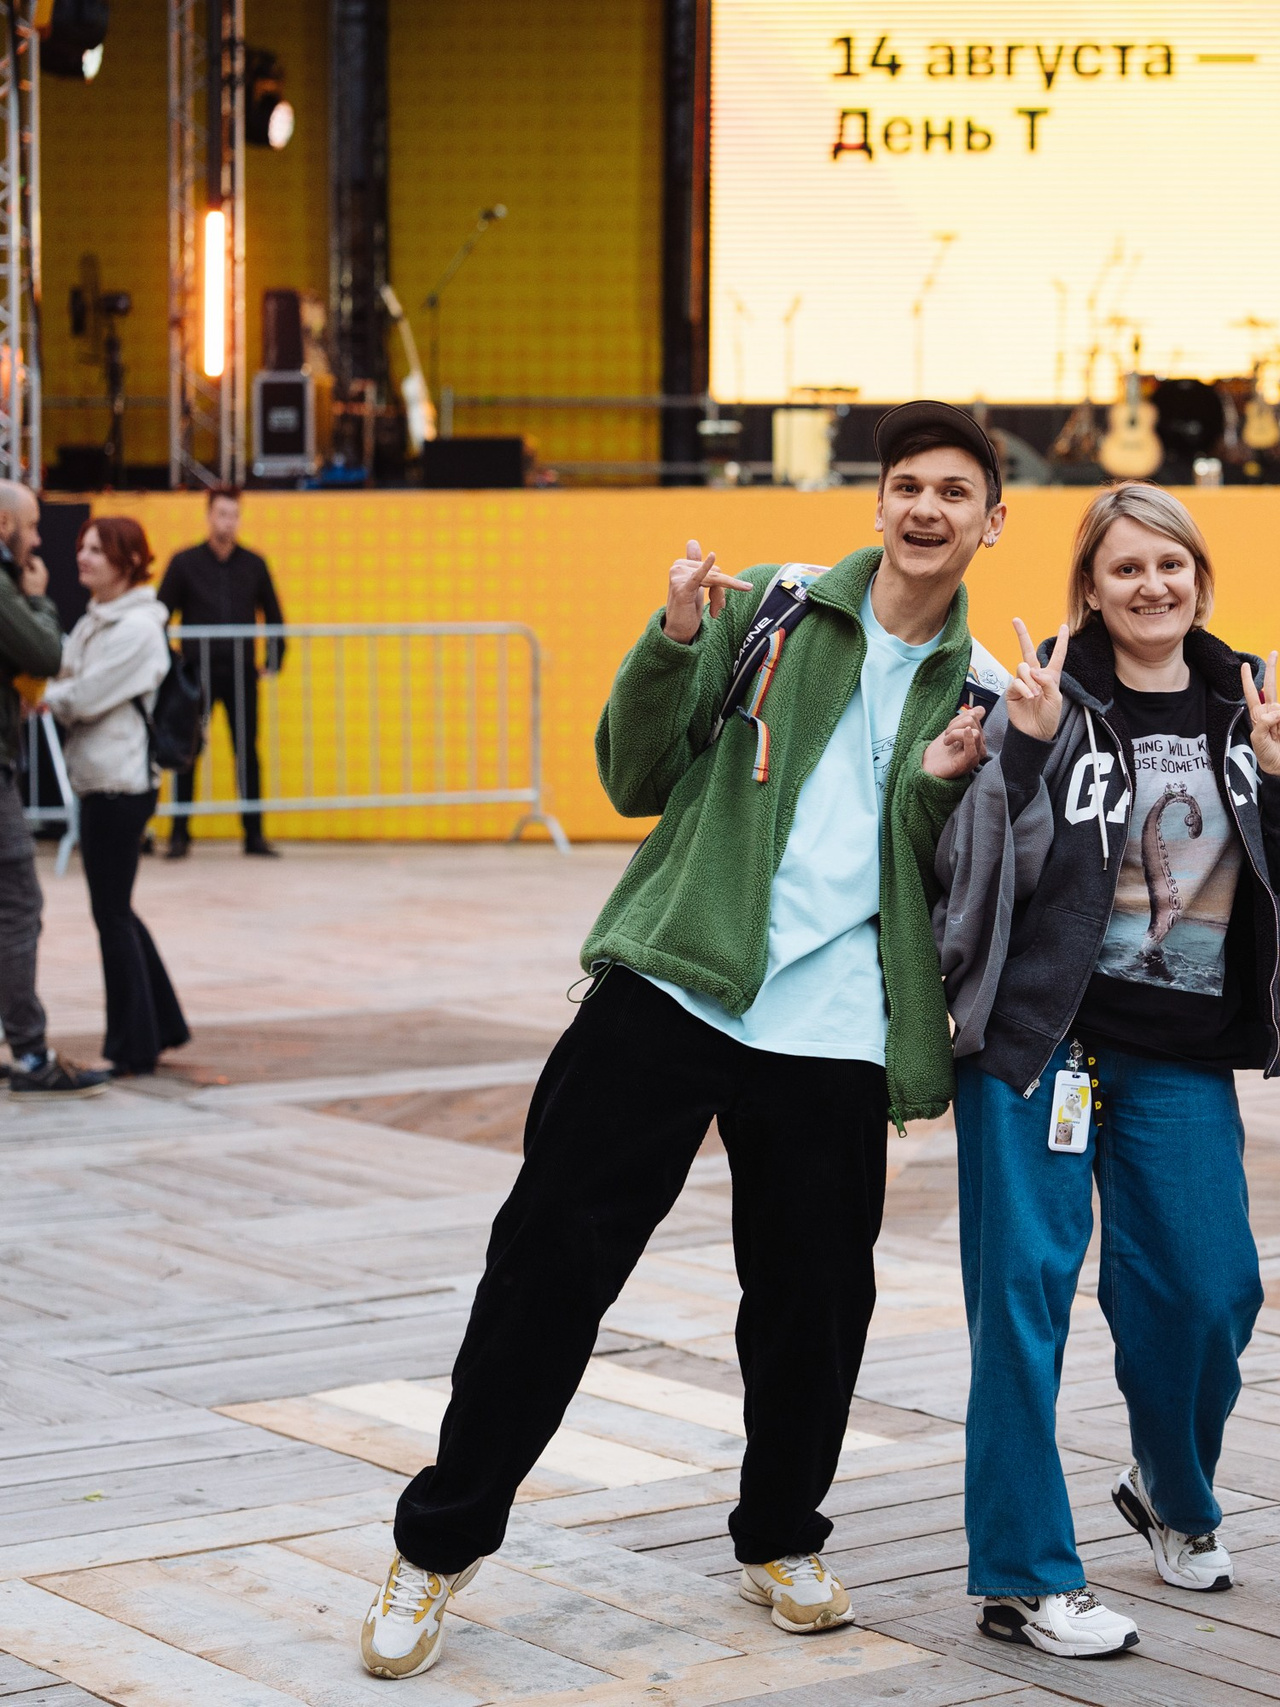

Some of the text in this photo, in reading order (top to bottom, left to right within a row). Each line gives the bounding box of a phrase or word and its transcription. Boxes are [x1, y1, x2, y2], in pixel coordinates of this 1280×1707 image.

[831, 36, 902, 78] 14
[926, 43, 1175, 90] августа
[831, 107, 1050, 161] День Т
[1134, 740, 1163, 754] HING
[1168, 740, 1194, 757] WILL
[1134, 756, 1212, 774] OSE SOMETH
